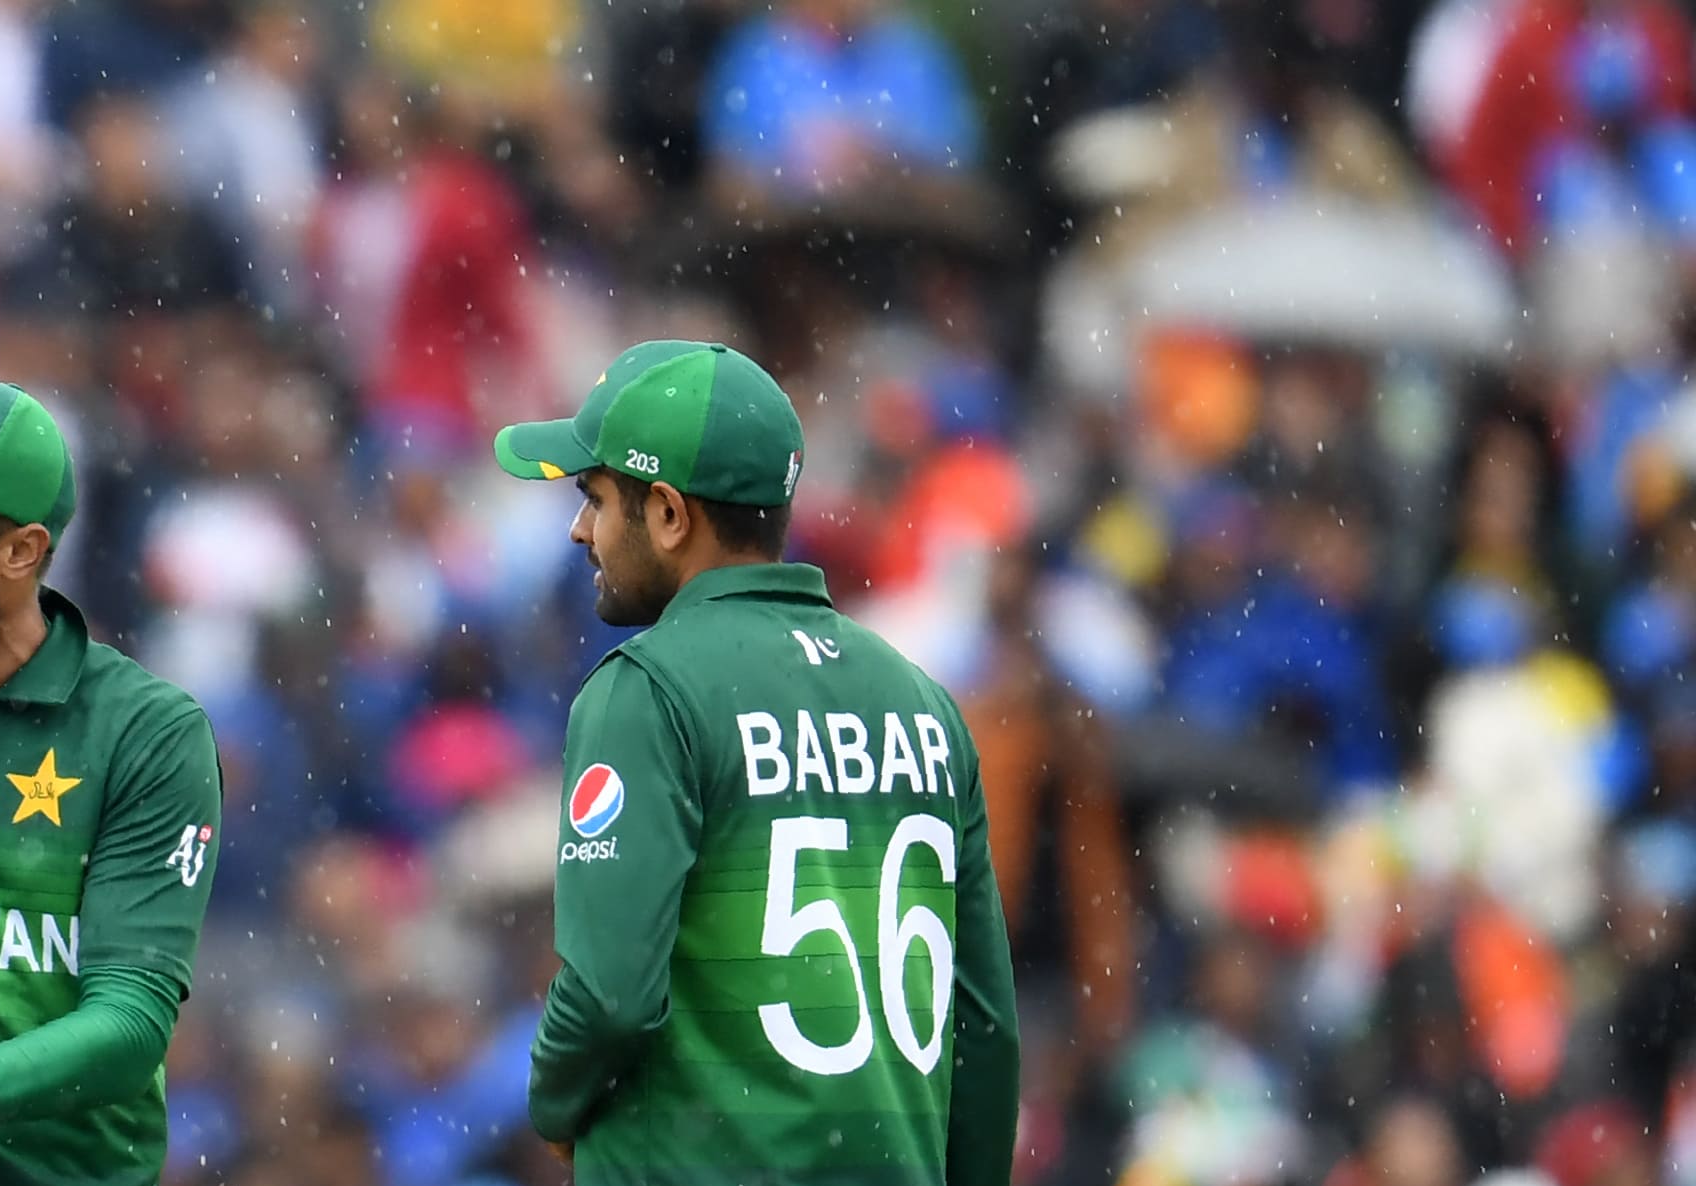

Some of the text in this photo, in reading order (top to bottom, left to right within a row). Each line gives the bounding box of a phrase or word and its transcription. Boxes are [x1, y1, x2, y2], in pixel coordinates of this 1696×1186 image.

[625, 448, 660, 474] 203
[736, 709, 955, 797] BABAR
[757, 813, 956, 1075] 56
